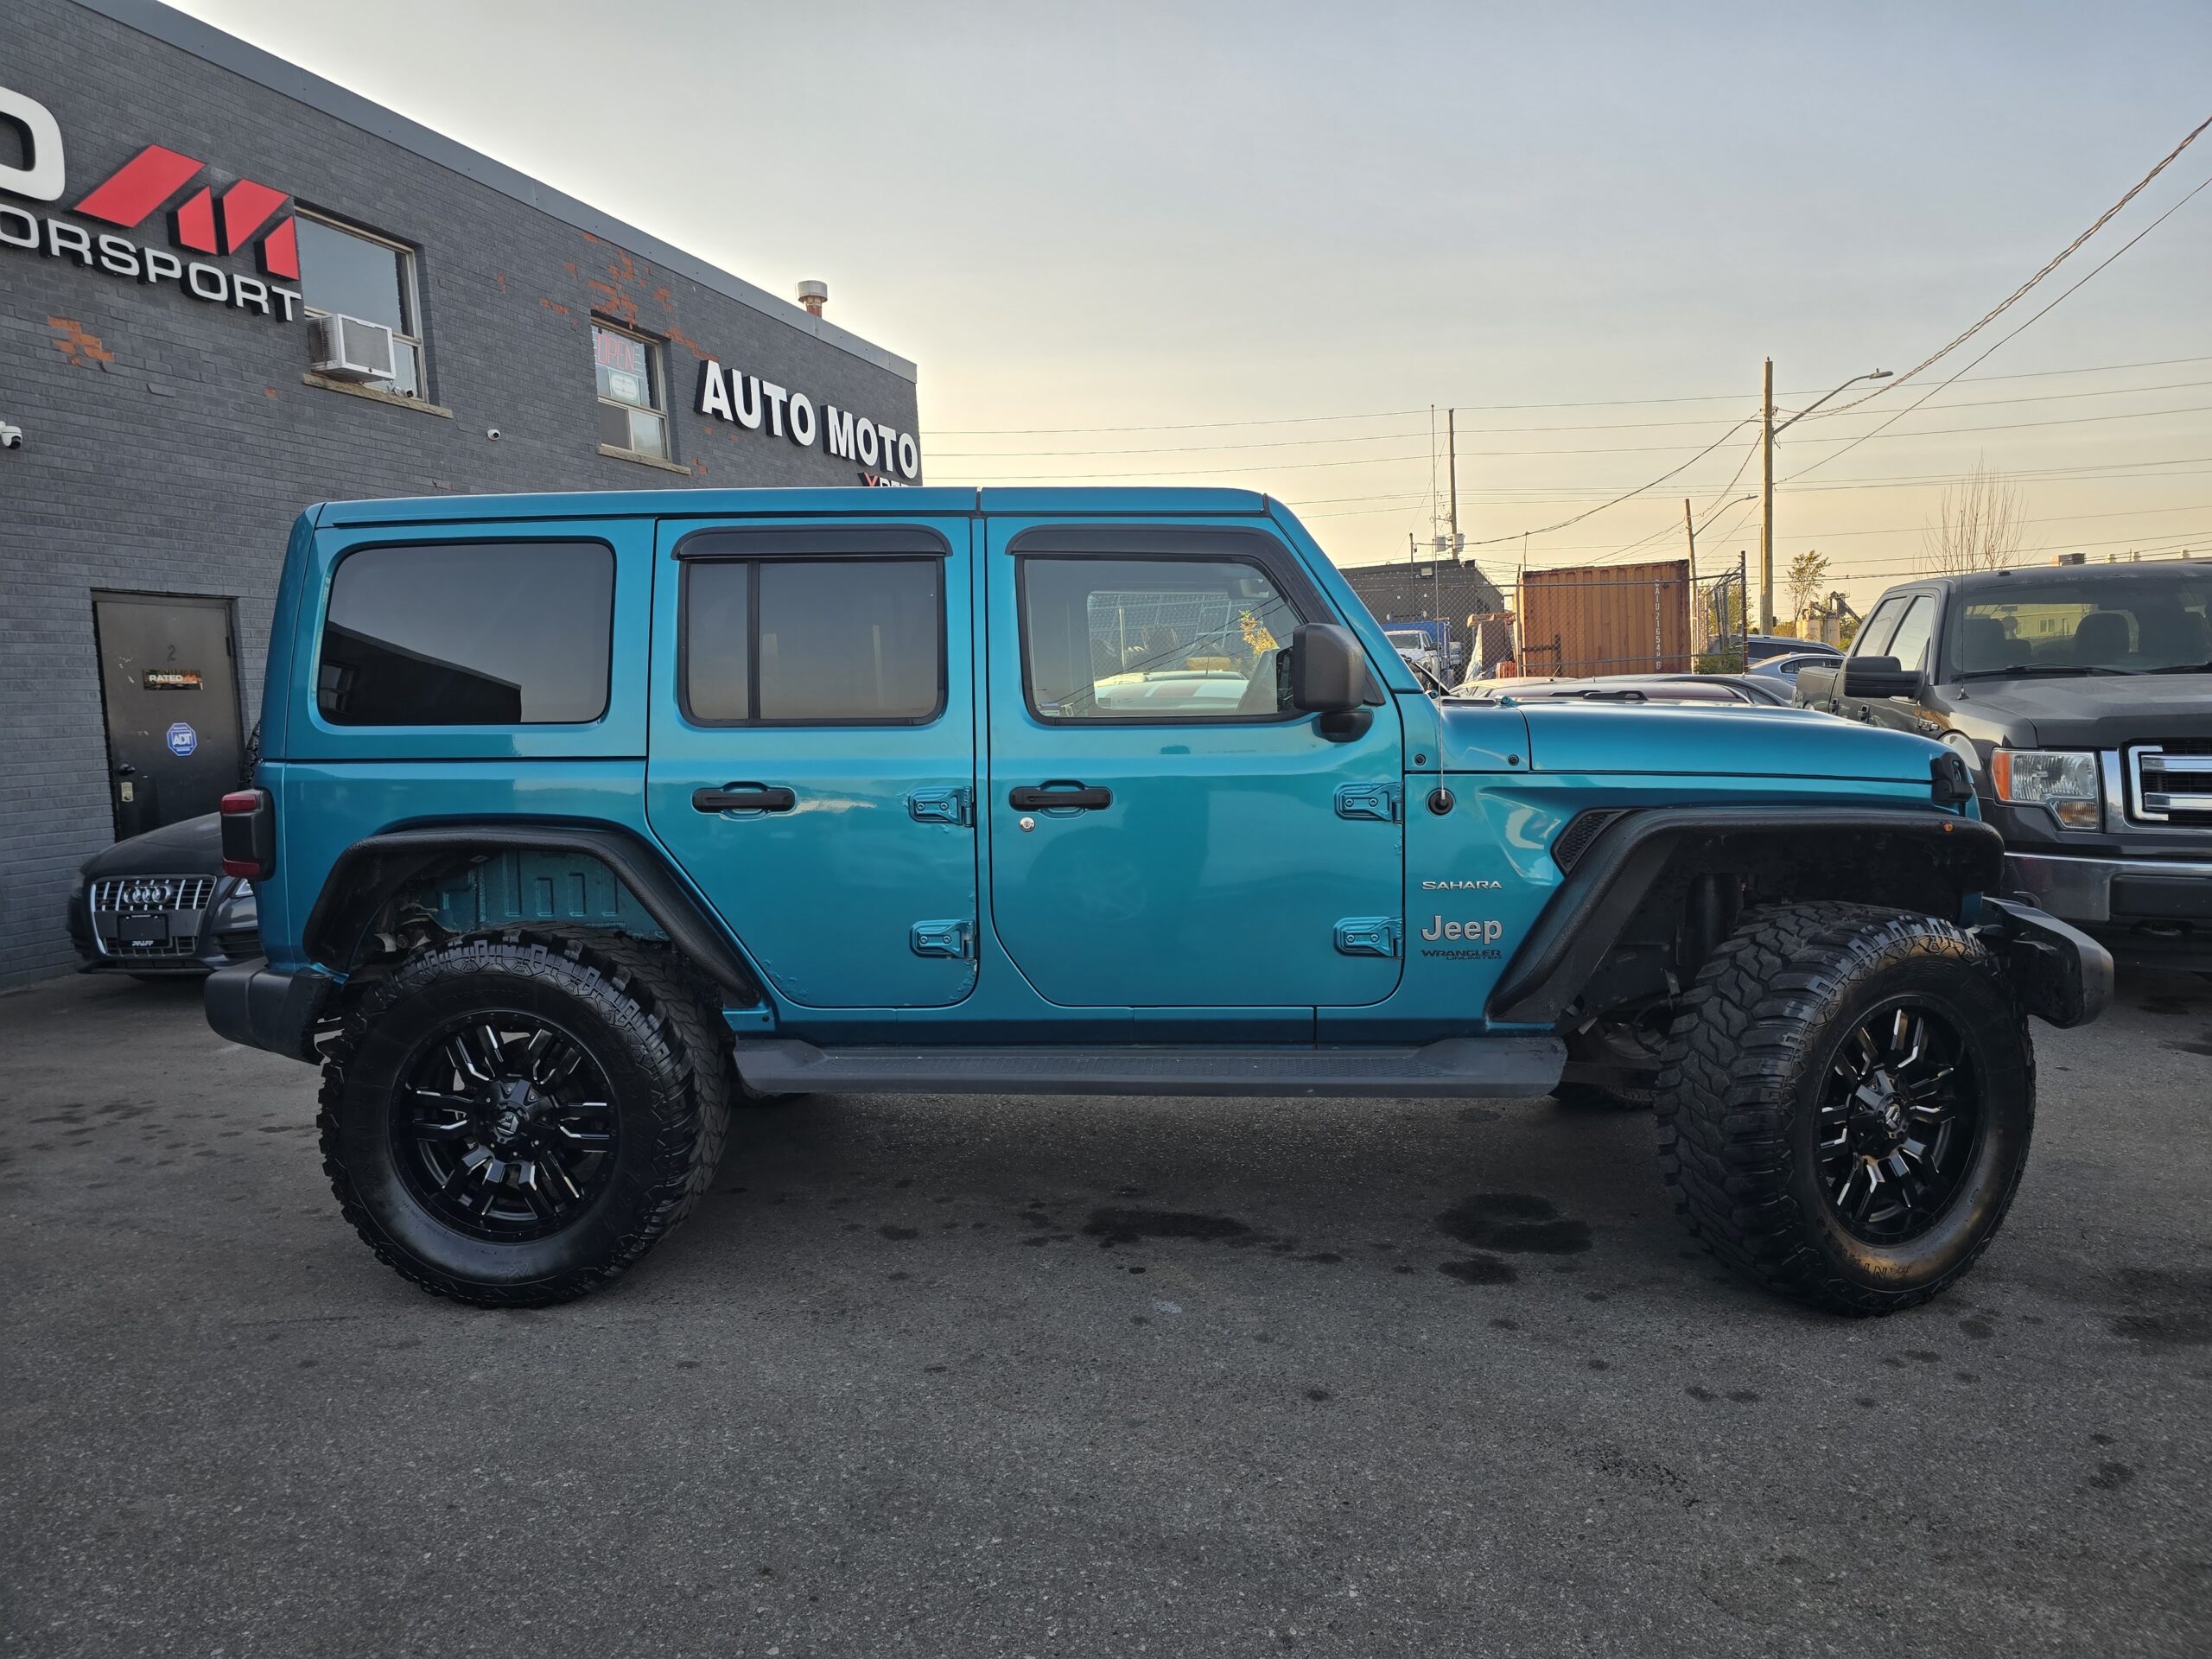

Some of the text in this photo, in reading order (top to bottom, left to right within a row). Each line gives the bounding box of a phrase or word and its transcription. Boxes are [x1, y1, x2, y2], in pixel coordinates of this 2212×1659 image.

[597, 333, 637, 374] OPEN
[701, 359, 918, 479] AUTO MOTO
[149, 674, 183, 683] RATED
[173, 733, 192, 746] ADT
[1421, 880, 1503, 890] SAHARA
[1421, 915, 1503, 944] Jeep
[1421, 949, 1502, 957] WRANGLER
